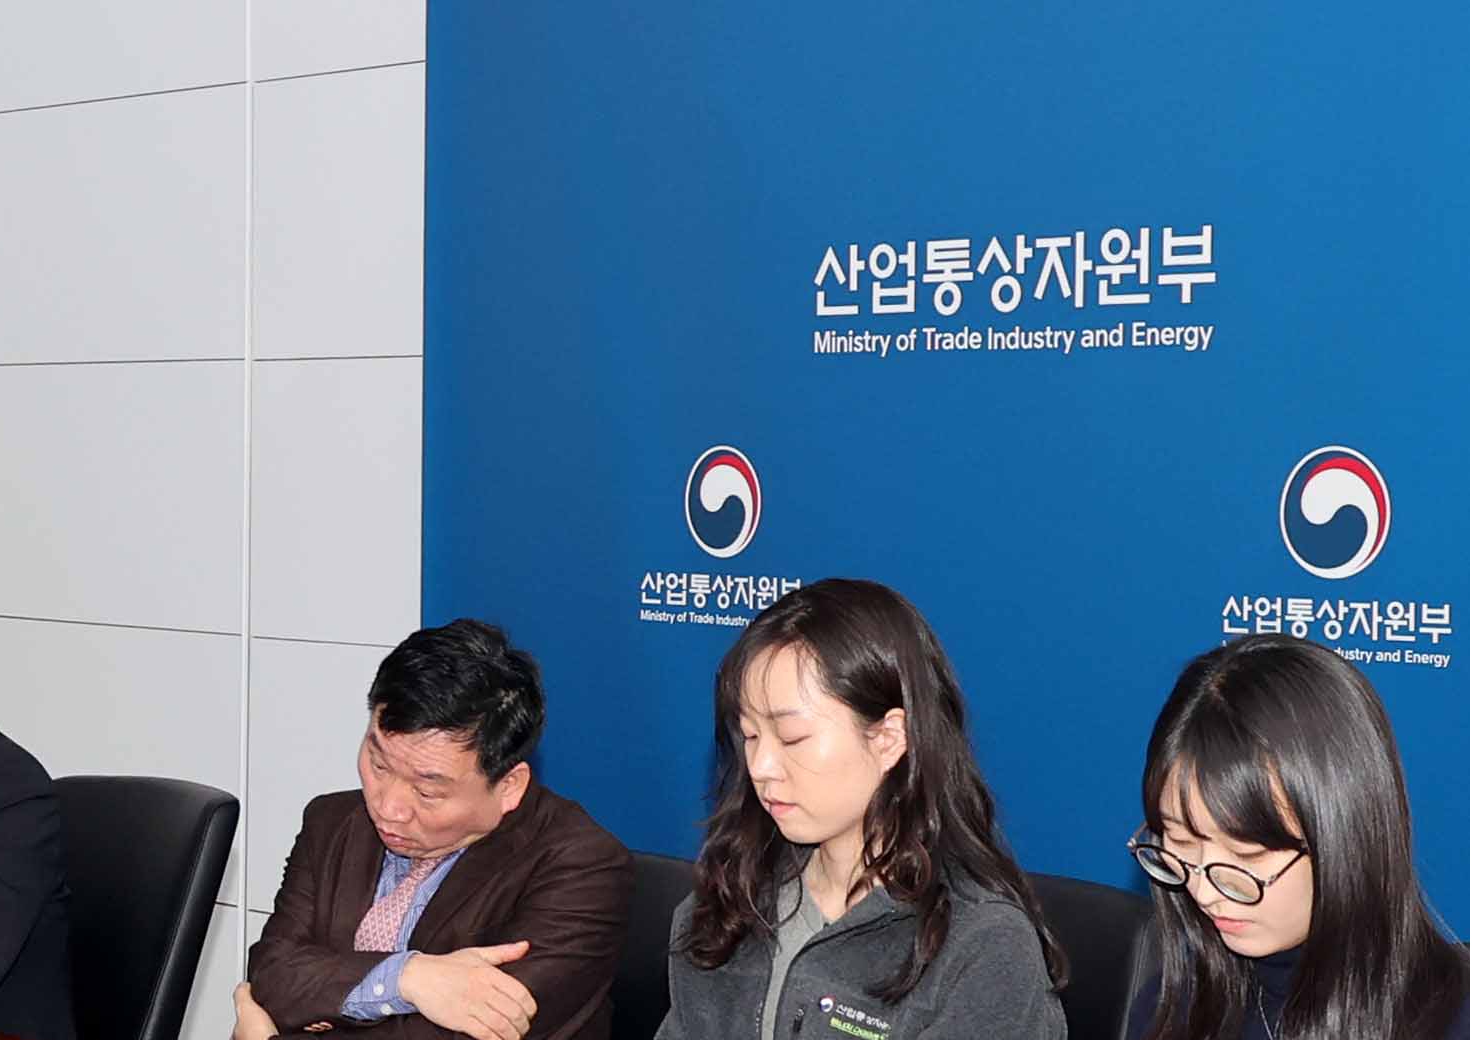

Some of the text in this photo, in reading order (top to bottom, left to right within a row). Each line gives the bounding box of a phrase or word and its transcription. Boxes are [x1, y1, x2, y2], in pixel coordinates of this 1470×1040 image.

[813, 225, 1217, 316] 산업통상자원부
[813, 321, 1213, 357] Ministry of Trade Industry and Energy
[640, 609, 750, 627] Ministry of Trade Industry
[1222, 596, 1452, 644] 산업통상자원부
[1375, 649, 1401, 663] and
[1405, 650, 1451, 667] Energy
